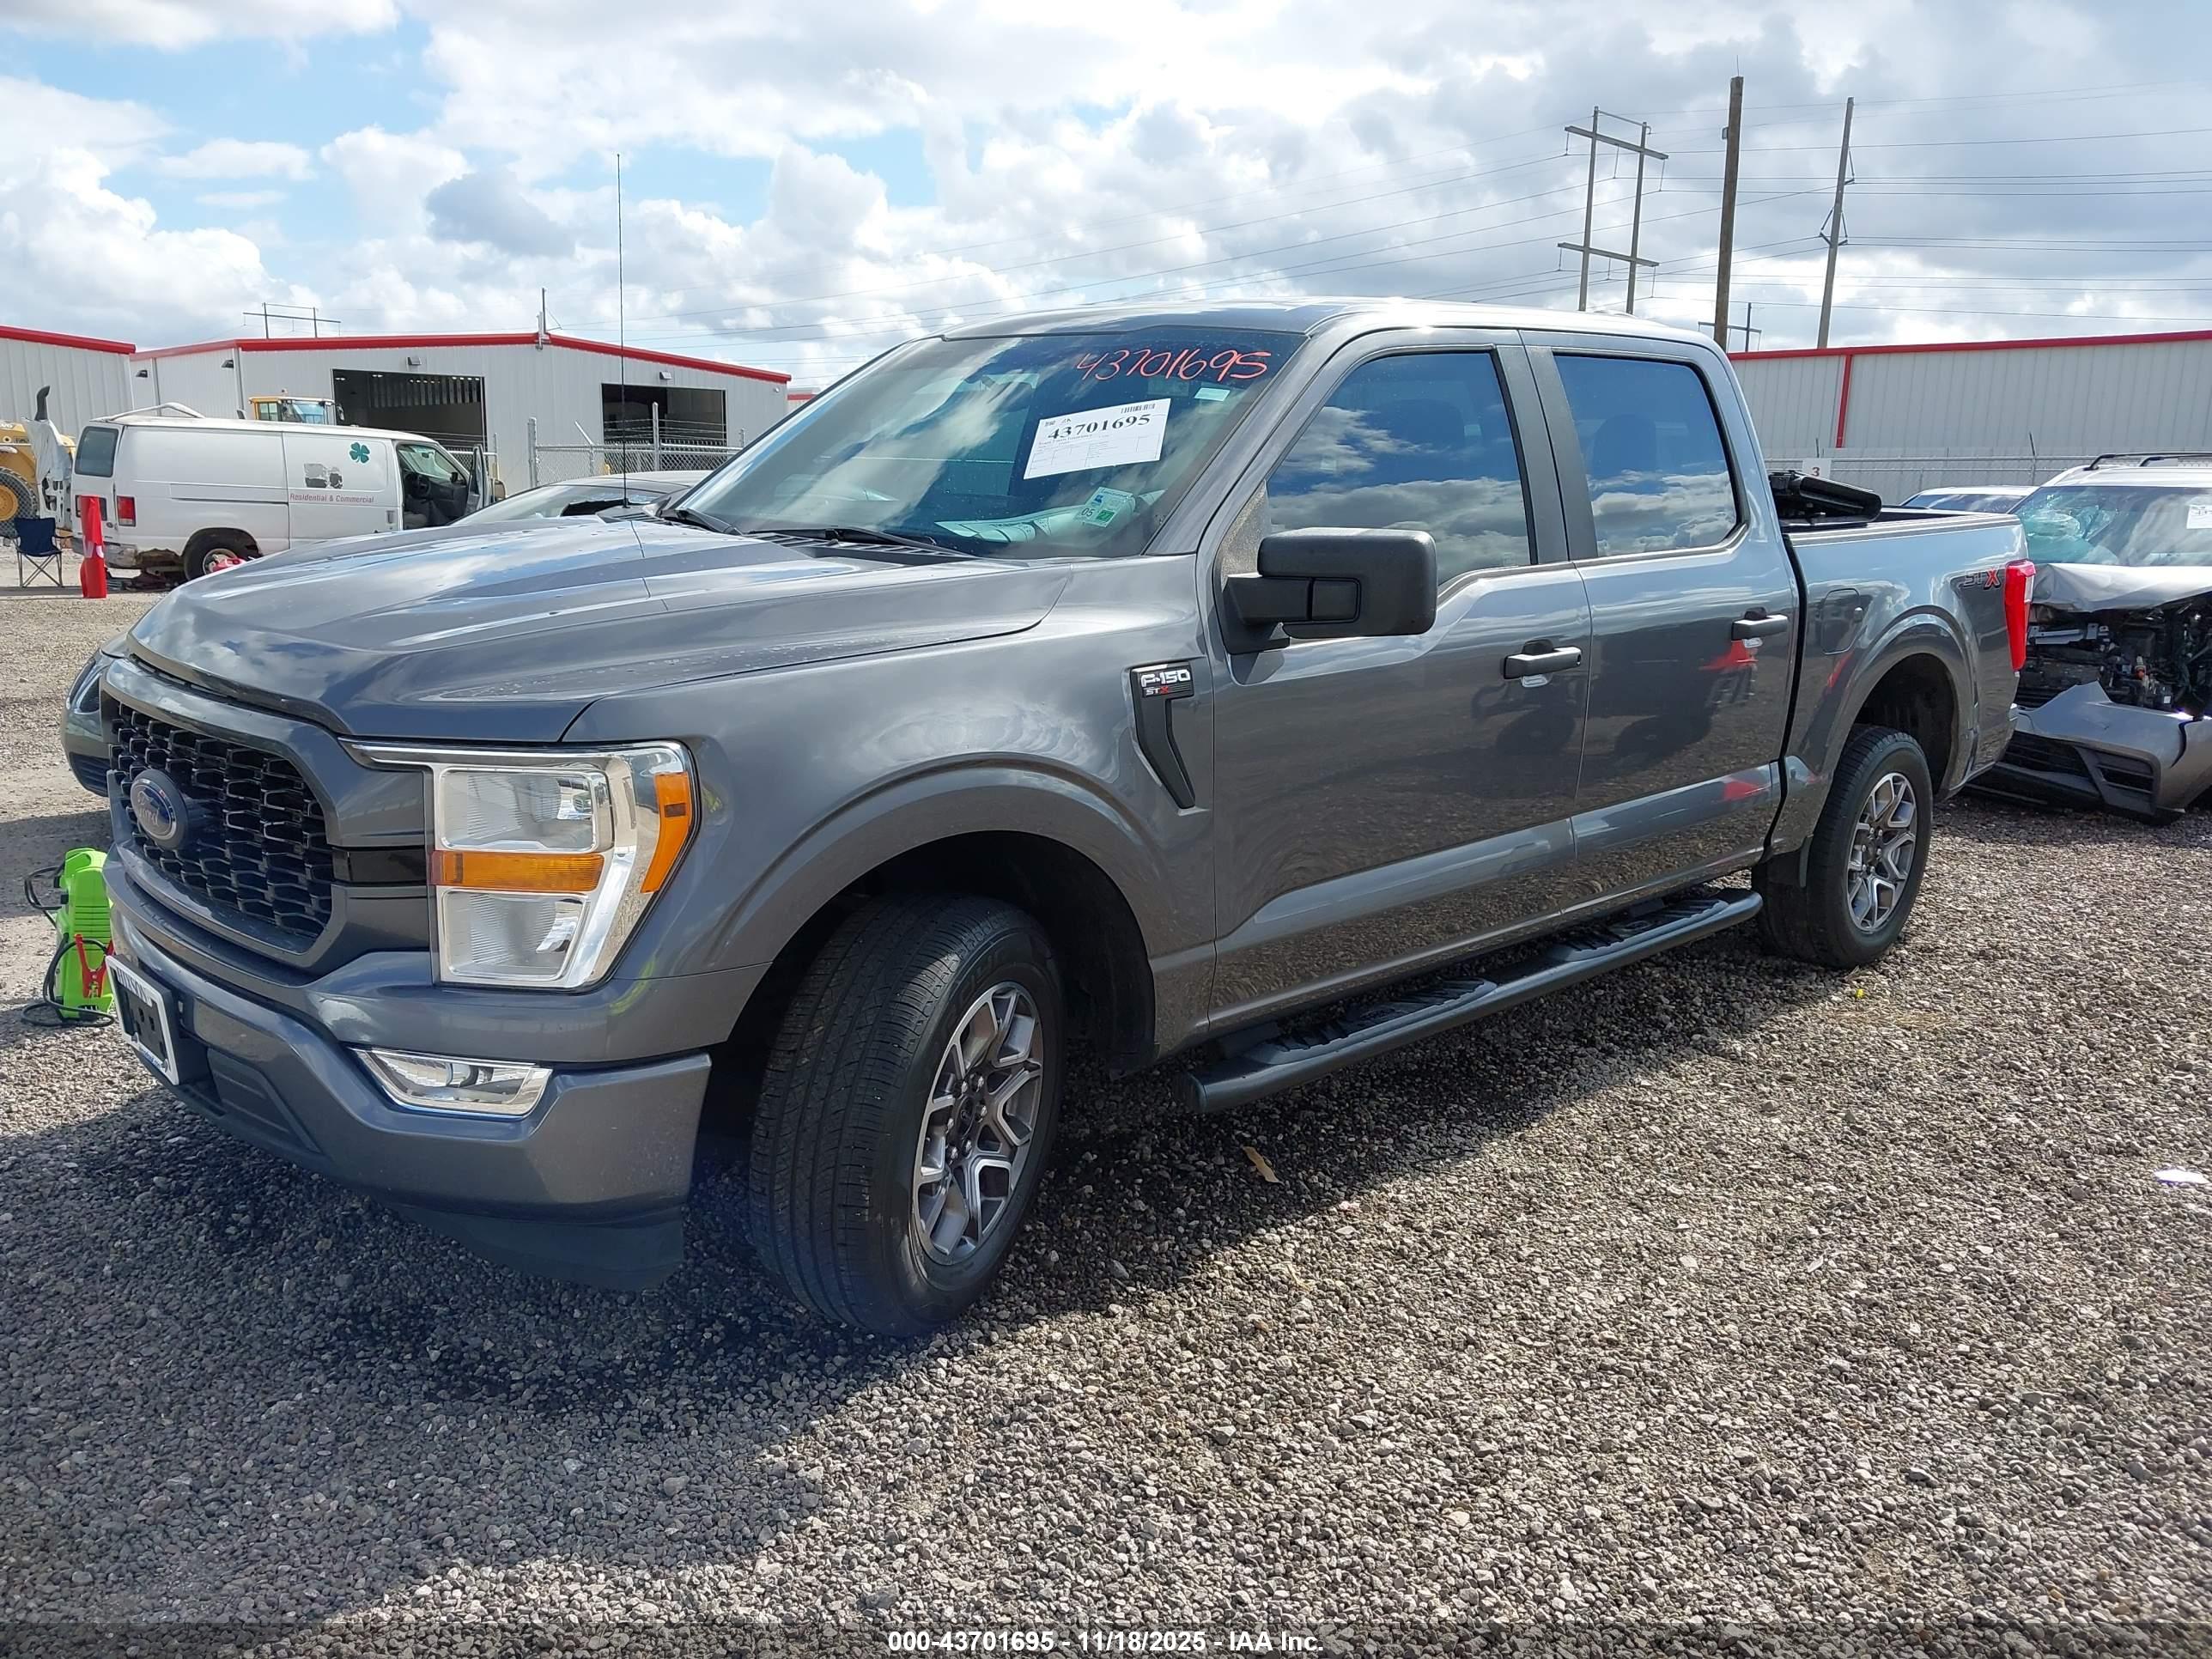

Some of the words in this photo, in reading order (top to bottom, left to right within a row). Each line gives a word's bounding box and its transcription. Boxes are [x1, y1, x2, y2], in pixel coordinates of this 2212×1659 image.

[1077, 348, 1272, 382] 43701695
[1048, 413, 1152, 440] 43701695
[1812, 466, 1820, 477] 3
[289, 493, 327, 501] Residential
[329, 494, 334, 502] &
[336, 495, 374, 503] Commercial
[1958, 568, 2002, 589] STX
[1140, 669, 1191, 688] F-150
[1143, 686, 1169, 696] STX
